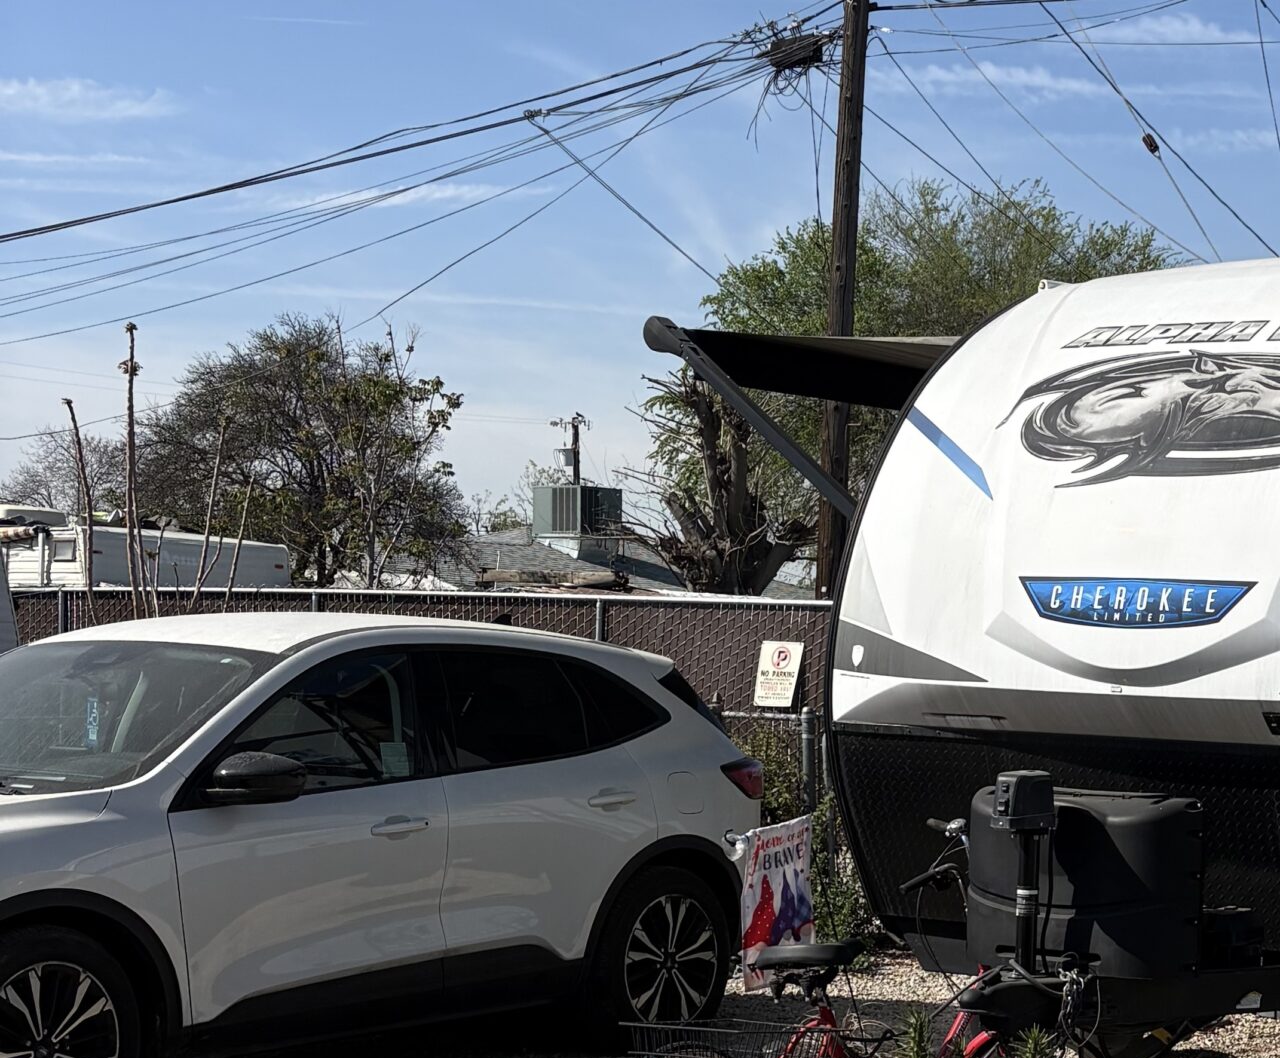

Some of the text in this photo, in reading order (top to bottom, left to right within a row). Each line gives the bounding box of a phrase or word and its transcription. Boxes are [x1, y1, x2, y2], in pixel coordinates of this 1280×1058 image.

[1062, 320, 1270, 348] ALPHA
[1050, 585, 1217, 613] CHEROKEE
[1094, 612, 1165, 623] LIMITED
[772, 670, 795, 678] PARKING
[763, 842, 804, 870] BRAVE
